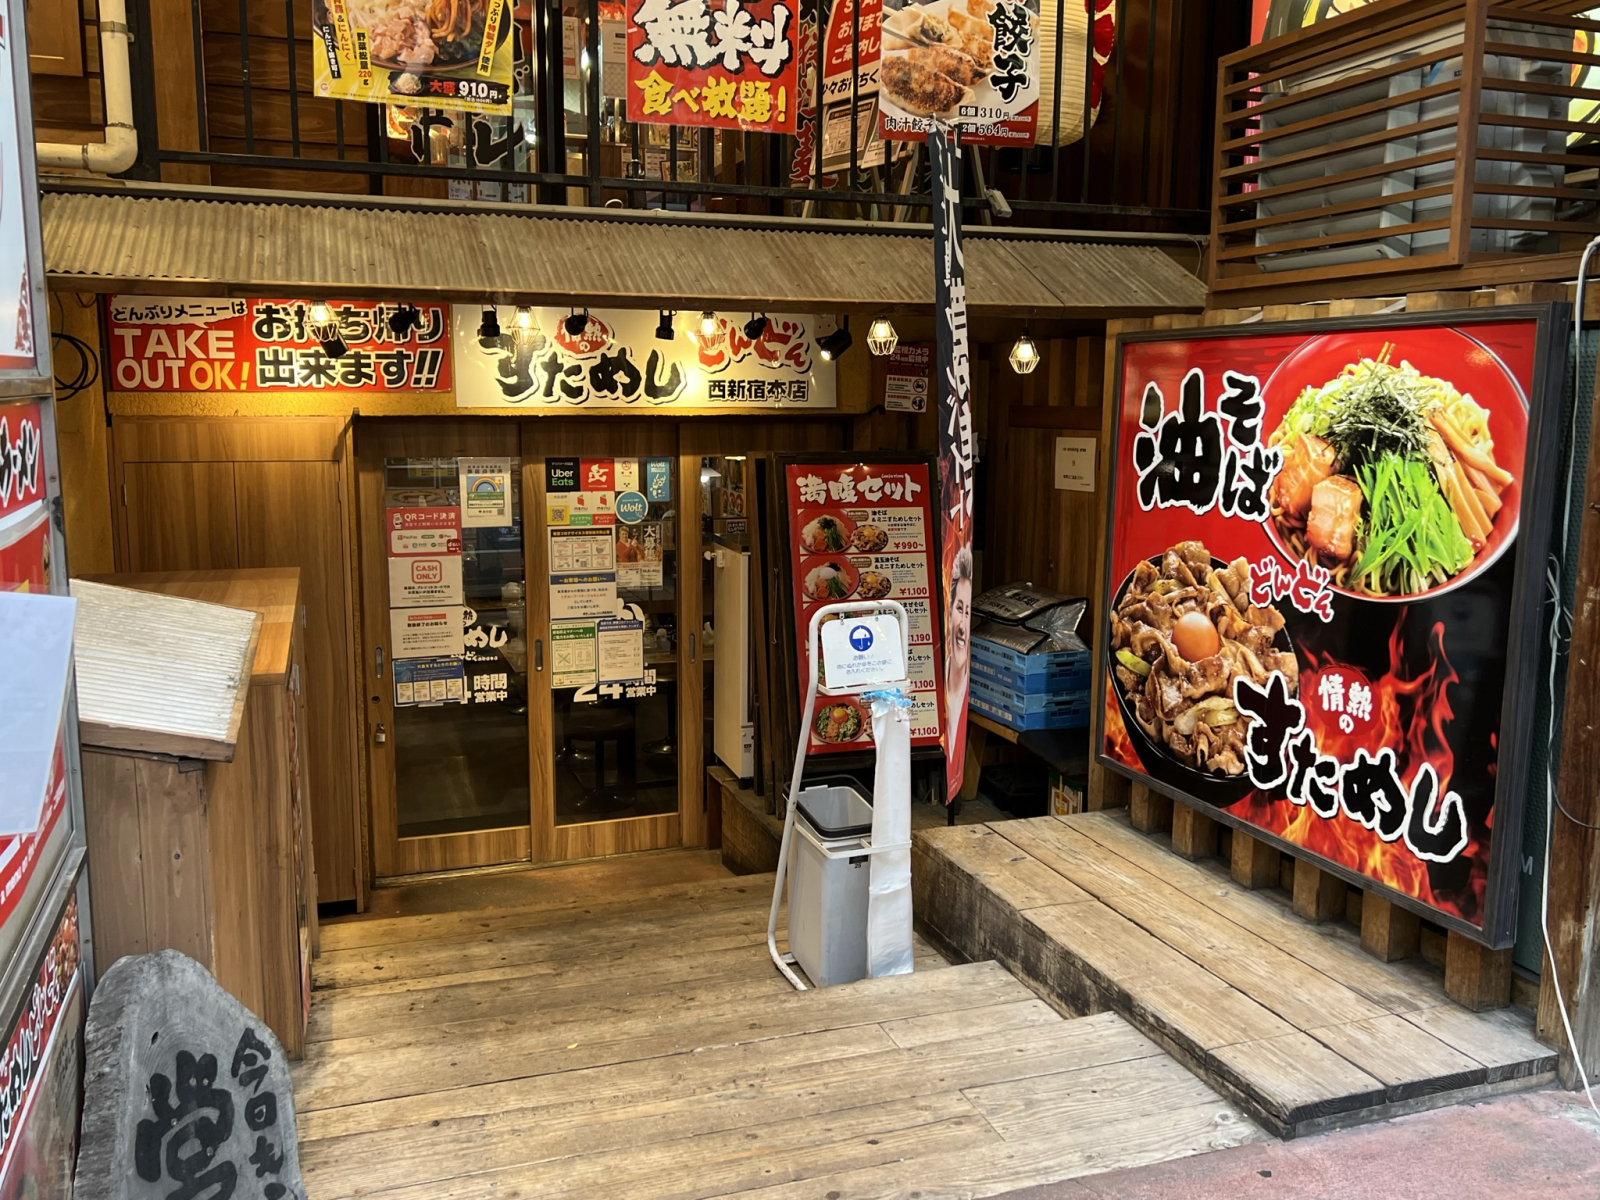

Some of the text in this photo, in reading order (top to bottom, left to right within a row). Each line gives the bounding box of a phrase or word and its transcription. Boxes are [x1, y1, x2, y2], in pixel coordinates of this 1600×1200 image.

[633, 0, 790, 76] 無料
[430, 79, 456, 95] 大盛
[957, 122, 976, 133] 2個
[113, 301, 246, 322] どんぶりメニューは
[114, 328, 236, 360] TAKE
[117, 358, 250, 390] OUT OK!
[708, 379, 808, 401] 西新宿本店
[1134, 367, 1284, 523] 油そば
[551, 469, 574, 478] Uber
[551, 478, 574, 486] Eats
[796, 473, 922, 504] 満腹セット
[620, 503, 643, 513] Wolt
[899, 587, 928, 596] ¥1,100
[1249, 556, 1334, 623] どんどん
[908, 633, 931, 643] 1,190
[474, 673, 508, 690] 時間
[474, 690, 508, 704] 営業中
[1318, 673, 1373, 734] 情熱の
[1234, 670, 1468, 862] すためし
